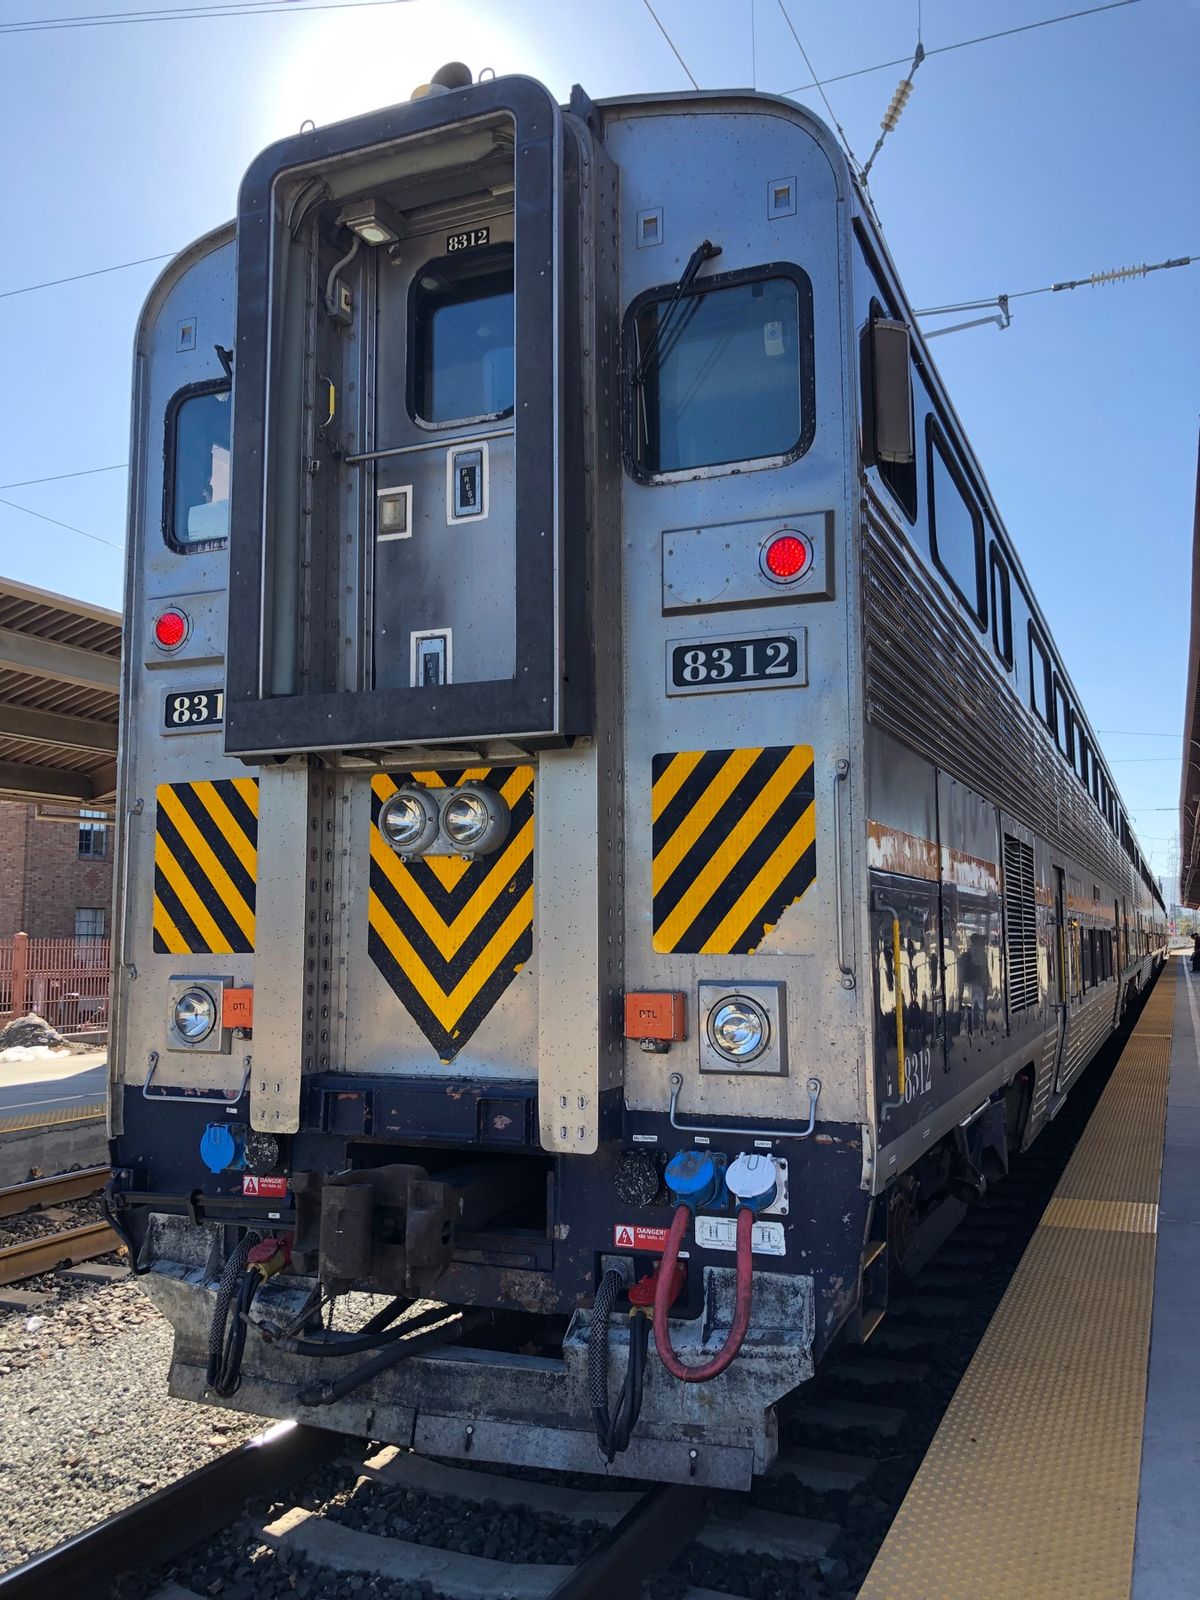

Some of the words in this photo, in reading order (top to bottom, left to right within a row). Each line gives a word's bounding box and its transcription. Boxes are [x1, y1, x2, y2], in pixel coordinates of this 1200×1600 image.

[448, 229, 487, 251] 8312
[462, 469, 475, 505] PRESS
[425, 654, 437, 685] PRES
[682, 642, 790, 682] 8312
[172, 693, 224, 724] 831
[904, 1047, 932, 1104] 8312
[636, 1227, 667, 1236] DANGER!
